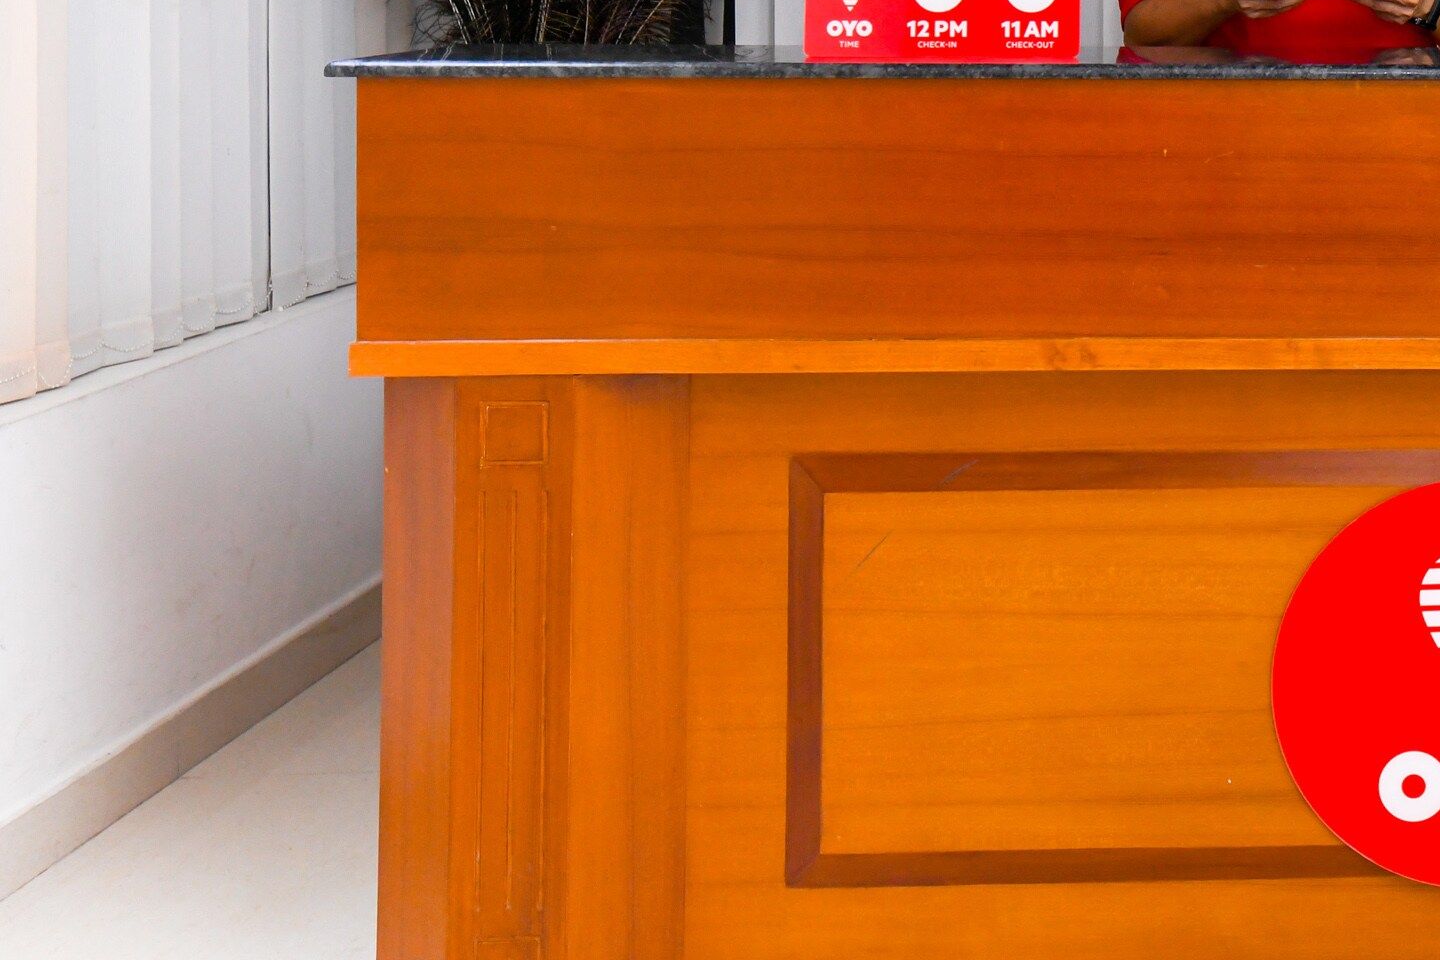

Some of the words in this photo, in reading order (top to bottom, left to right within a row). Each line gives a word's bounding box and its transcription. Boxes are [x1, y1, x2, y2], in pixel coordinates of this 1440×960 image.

[826, 20, 873, 38] OYO
[906, 20, 930, 38] 12
[934, 20, 968, 38] PM
[1001, 20, 1021, 38] 11
[1024, 20, 1059, 38] AM
[917, 41, 957, 49] CHECK-IN
[1005, 41, 1054, 49] CHECK-OUT
